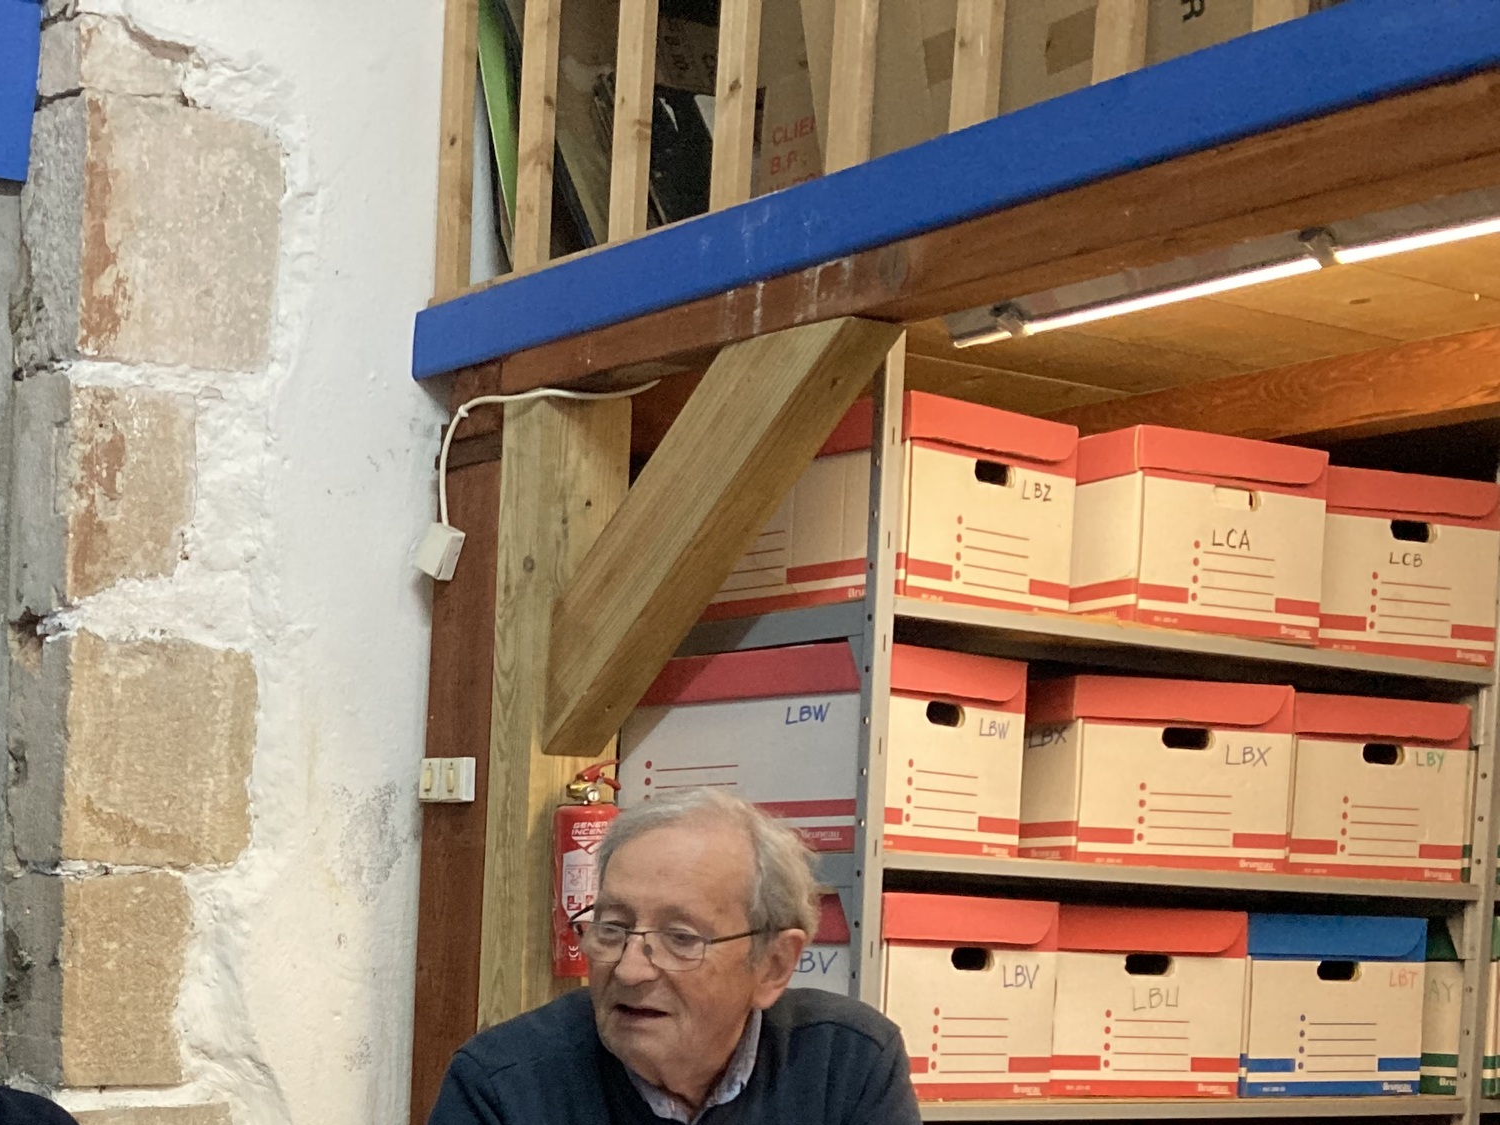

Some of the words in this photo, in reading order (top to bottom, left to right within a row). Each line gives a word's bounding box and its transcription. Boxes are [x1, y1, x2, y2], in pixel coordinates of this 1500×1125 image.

[1022, 479, 1052, 502] LBZ
[1211, 528, 1251, 551] LCA
[1389, 552, 1423, 568] LCB
[785, 702, 831, 725] LBW
[979, 717, 1011, 739] LBW
[1028, 725, 1068, 748] LBX
[1225, 745, 1272, 767] LBX
[1415, 751, 1445, 773] LBY
[1003, 964, 1040, 989] LBV
[1389, 968, 1419, 989] LBT
[1131, 986, 1180, 1012] LBU
